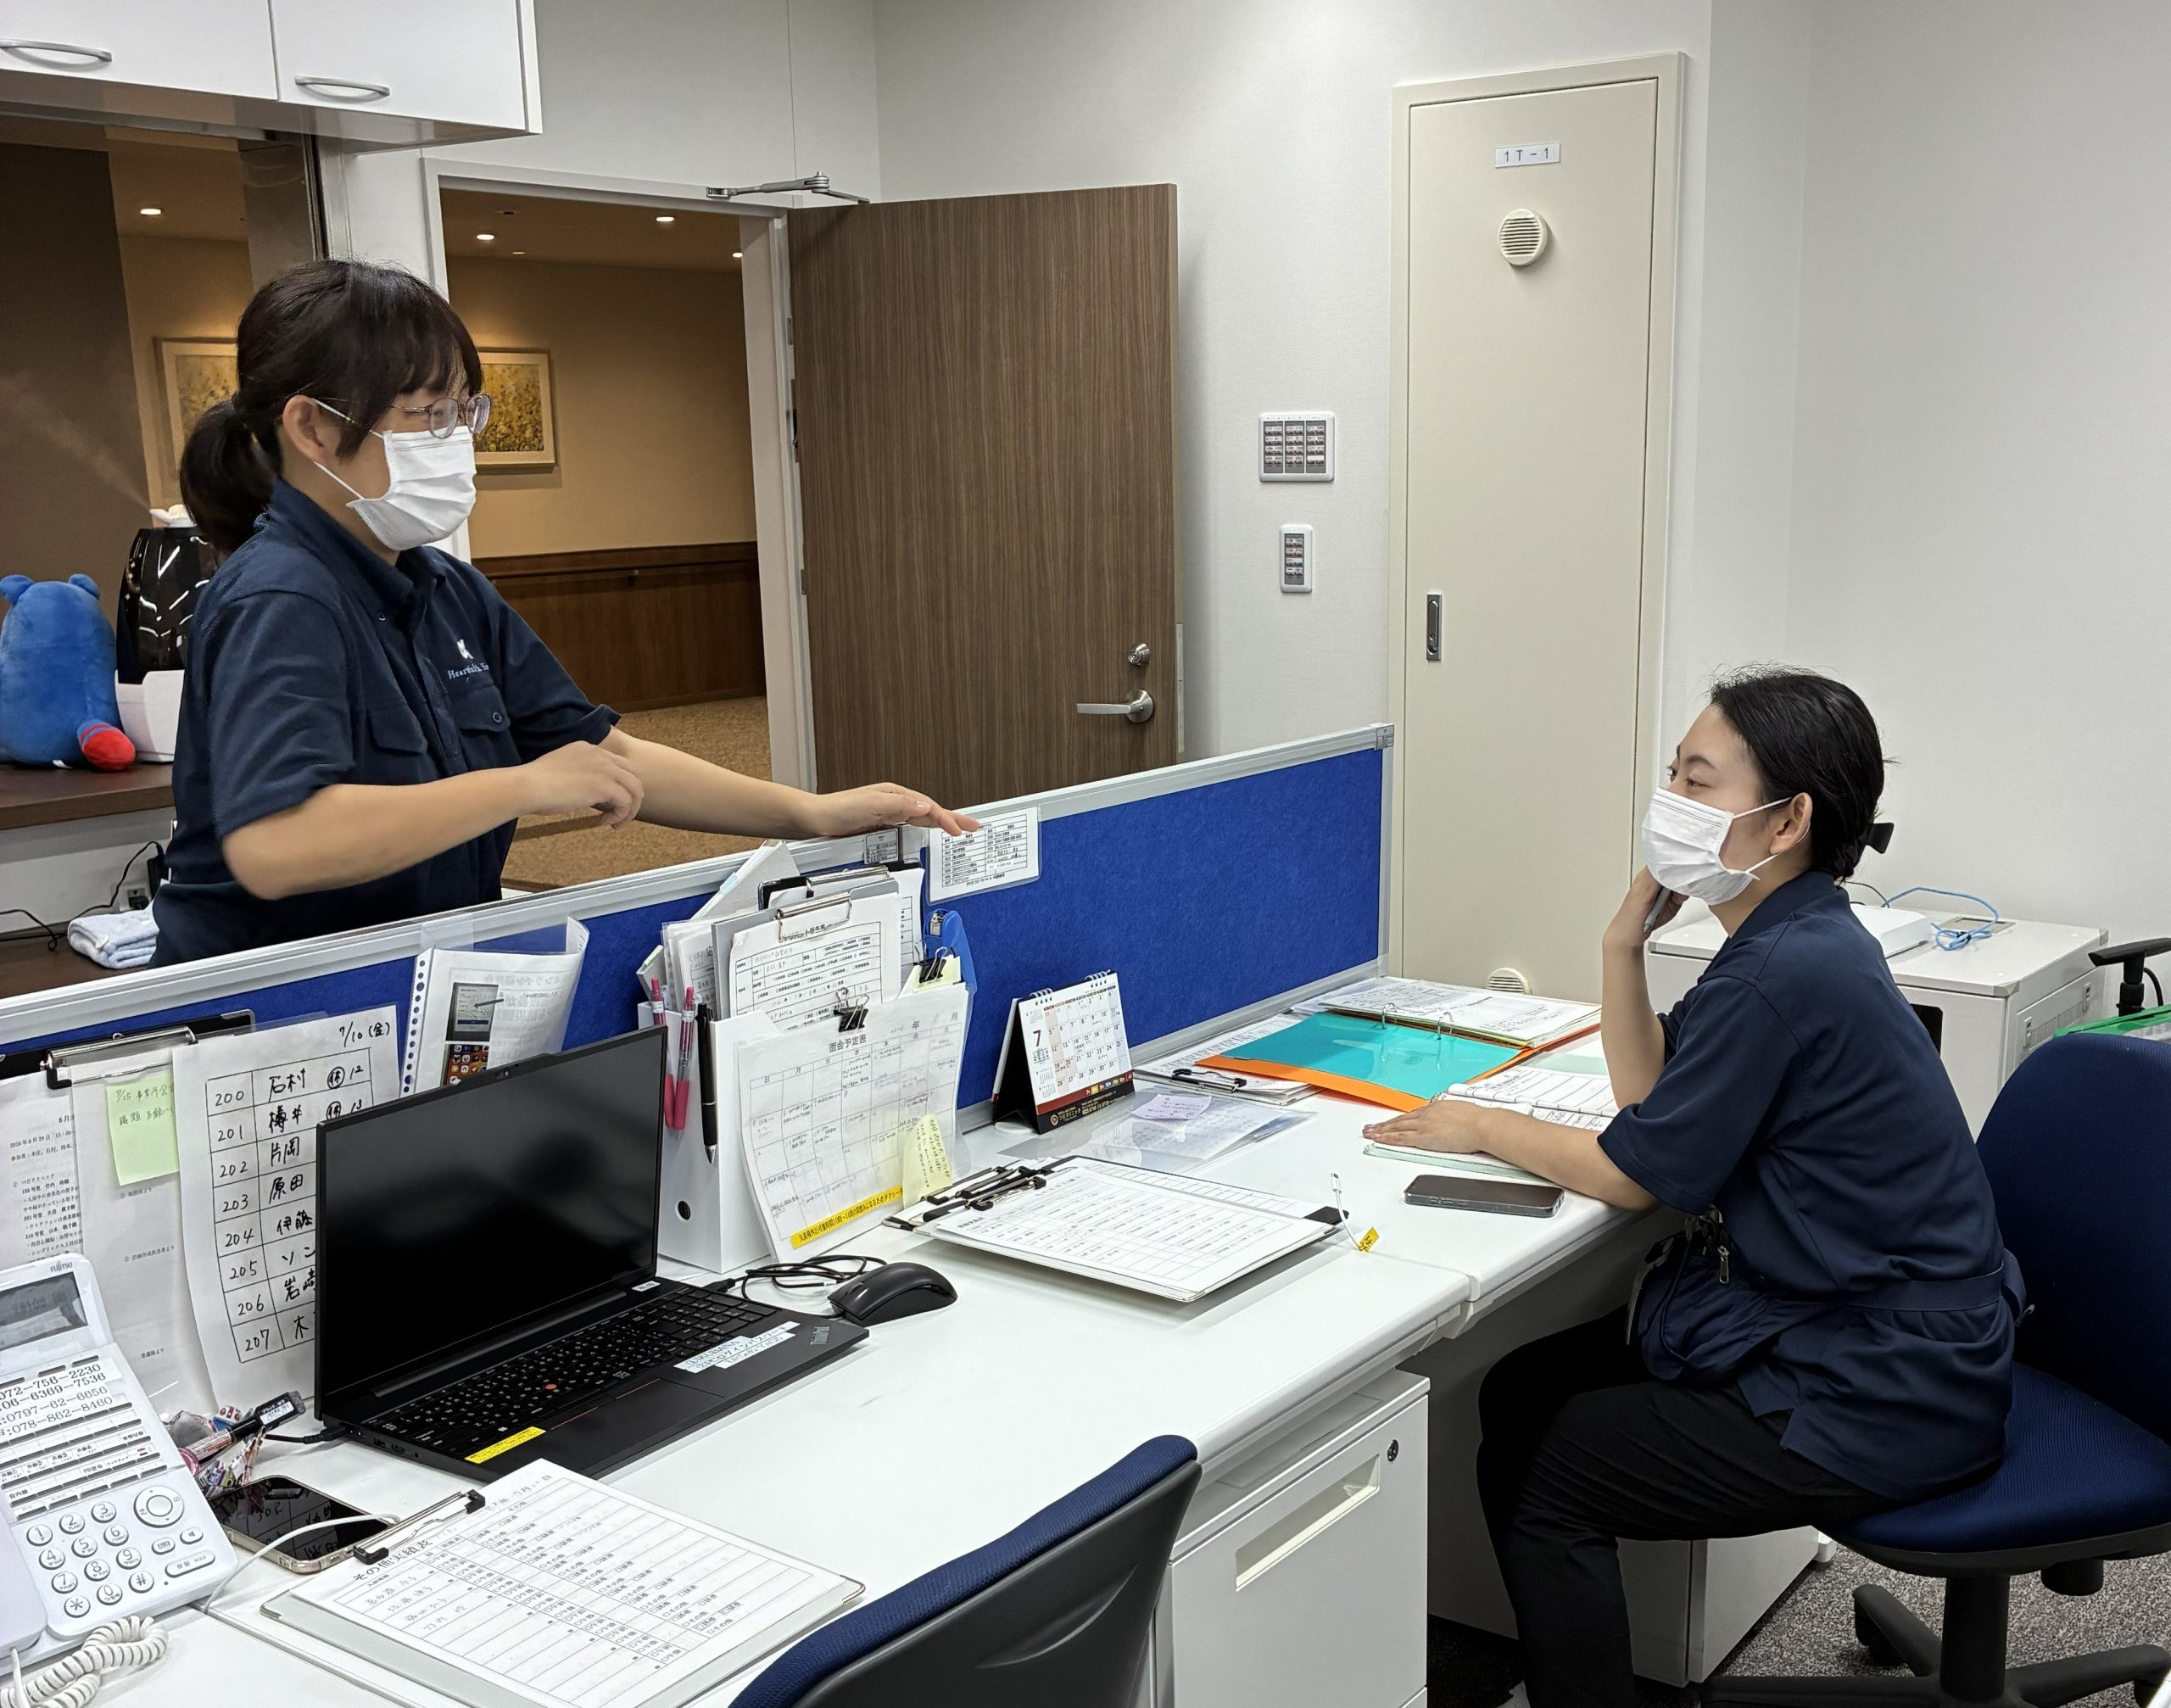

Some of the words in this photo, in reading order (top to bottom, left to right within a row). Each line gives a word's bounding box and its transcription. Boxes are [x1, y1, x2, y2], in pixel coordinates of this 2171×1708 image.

[339, 1022, 363, 1048] 7/10
[368, 1021, 390, 1038] (金)
[829, 1034, 867, 1052] 面会予定表
[1033, 1030, 1041, 1047] 7
[215, 1091, 244, 1106] 200
[268, 1068, 305, 1103] 石村
[217, 1125, 243, 1141] 201
[220, 1161, 248, 1178] 202
[223, 1194, 248, 1212] 203
[269, 1174, 304, 1204] 原田
[225, 1228, 254, 1248] 204
[276, 1209, 313, 1235] 伊藤
[50, 1260, 73, 1272] FUJITSU
[230, 1260, 258, 1280] 205
[238, 1294, 264, 1315] 206
[245, 1329, 269, 1352] 207
[293, 1316, 310, 1339] 木
[35, 1527, 42, 1538] 1
[66, 1515, 77, 1526] 2
[98, 1504, 108, 1515] 3
[47, 1550, 56, 1560] 4
[79, 1538, 89, 1550] 5
[110, 1526, 120, 1537] 6
[58, 1573, 66, 1585] 7
[91, 1561, 102, 1572] 8
[123, 1549, 132, 1560] 9
[103, 1585, 114, 1596] 0
